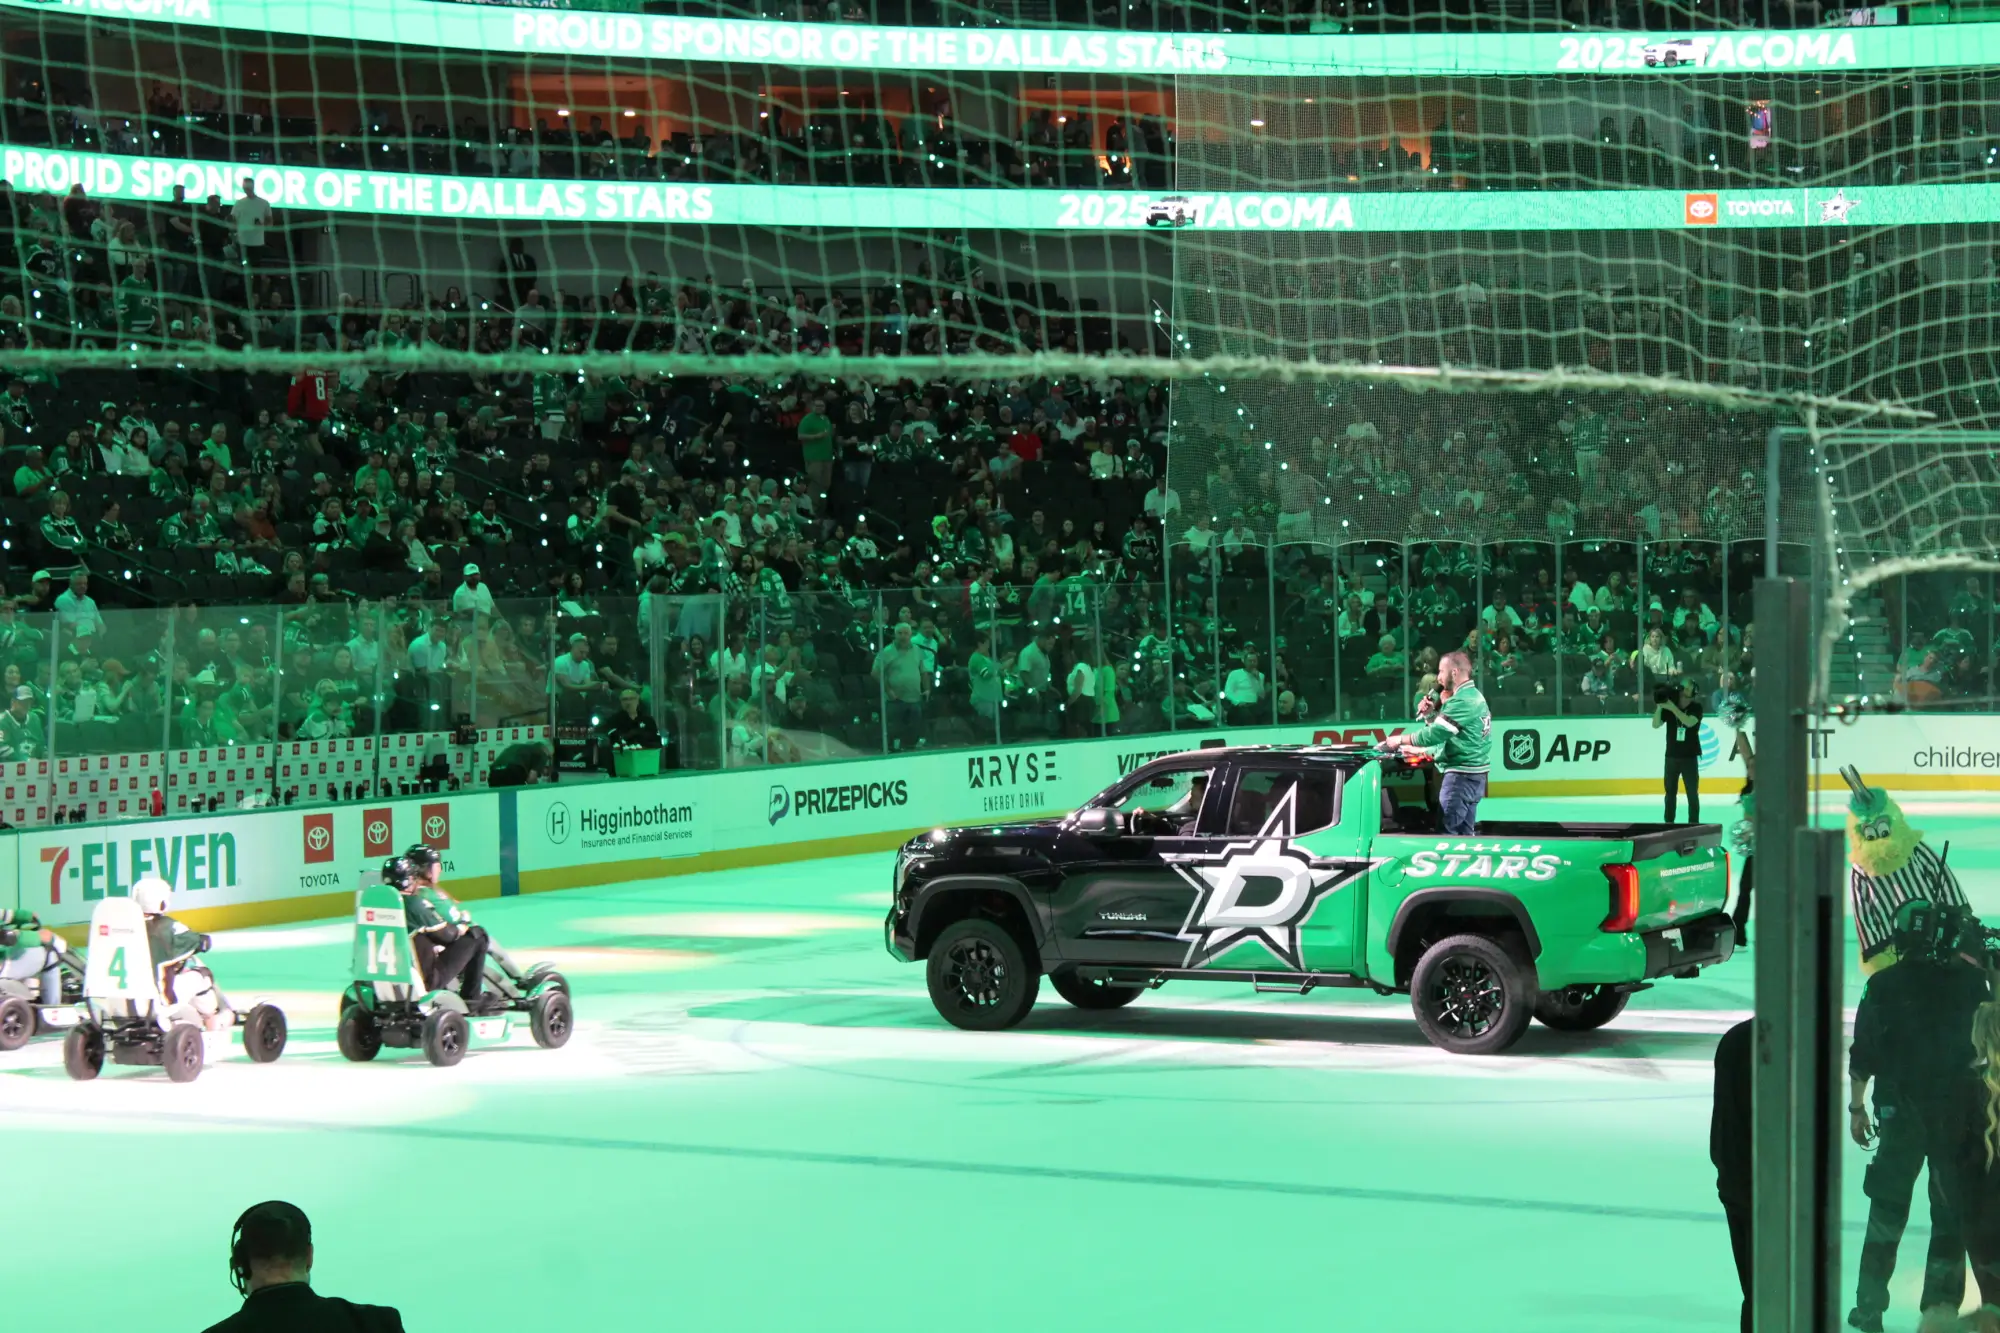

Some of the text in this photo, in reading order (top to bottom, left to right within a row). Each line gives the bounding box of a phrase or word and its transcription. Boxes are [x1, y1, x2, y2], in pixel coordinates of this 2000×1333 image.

[513, 13, 1228, 70] PROUD SPONSOR OF THE DALLAS STARS
[1556, 33, 1857, 69] 2025 TACOMA
[4, 150, 713, 220] PROUD SPONSOR OF THE DALLAS STARS
[1056, 194, 1355, 229] 2025 TACOMA
[1726, 199, 1794, 217] TOYOTA
[315, 376, 326, 400] 8
[1065, 592, 1086, 615] 14
[1312, 728, 1406, 746] DEX
[989, 751, 1057, 788] RYSE
[1914, 746, 2000, 768] childre
[794, 779, 908, 817] PRIZEPICKS
[983, 791, 1045, 812] ENERGY DRINK
[580, 803, 693, 835] Higginbotham
[581, 829, 693, 849] Insurance and Financial Services
[1434, 842, 1542, 853] DALLAS
[299, 873, 340, 889] TOYOTA
[1402, 851, 1561, 881] STARS
[1198, 855, 1311, 927] D
[108, 946, 128, 990] 4
[366, 930, 398, 976] 14
